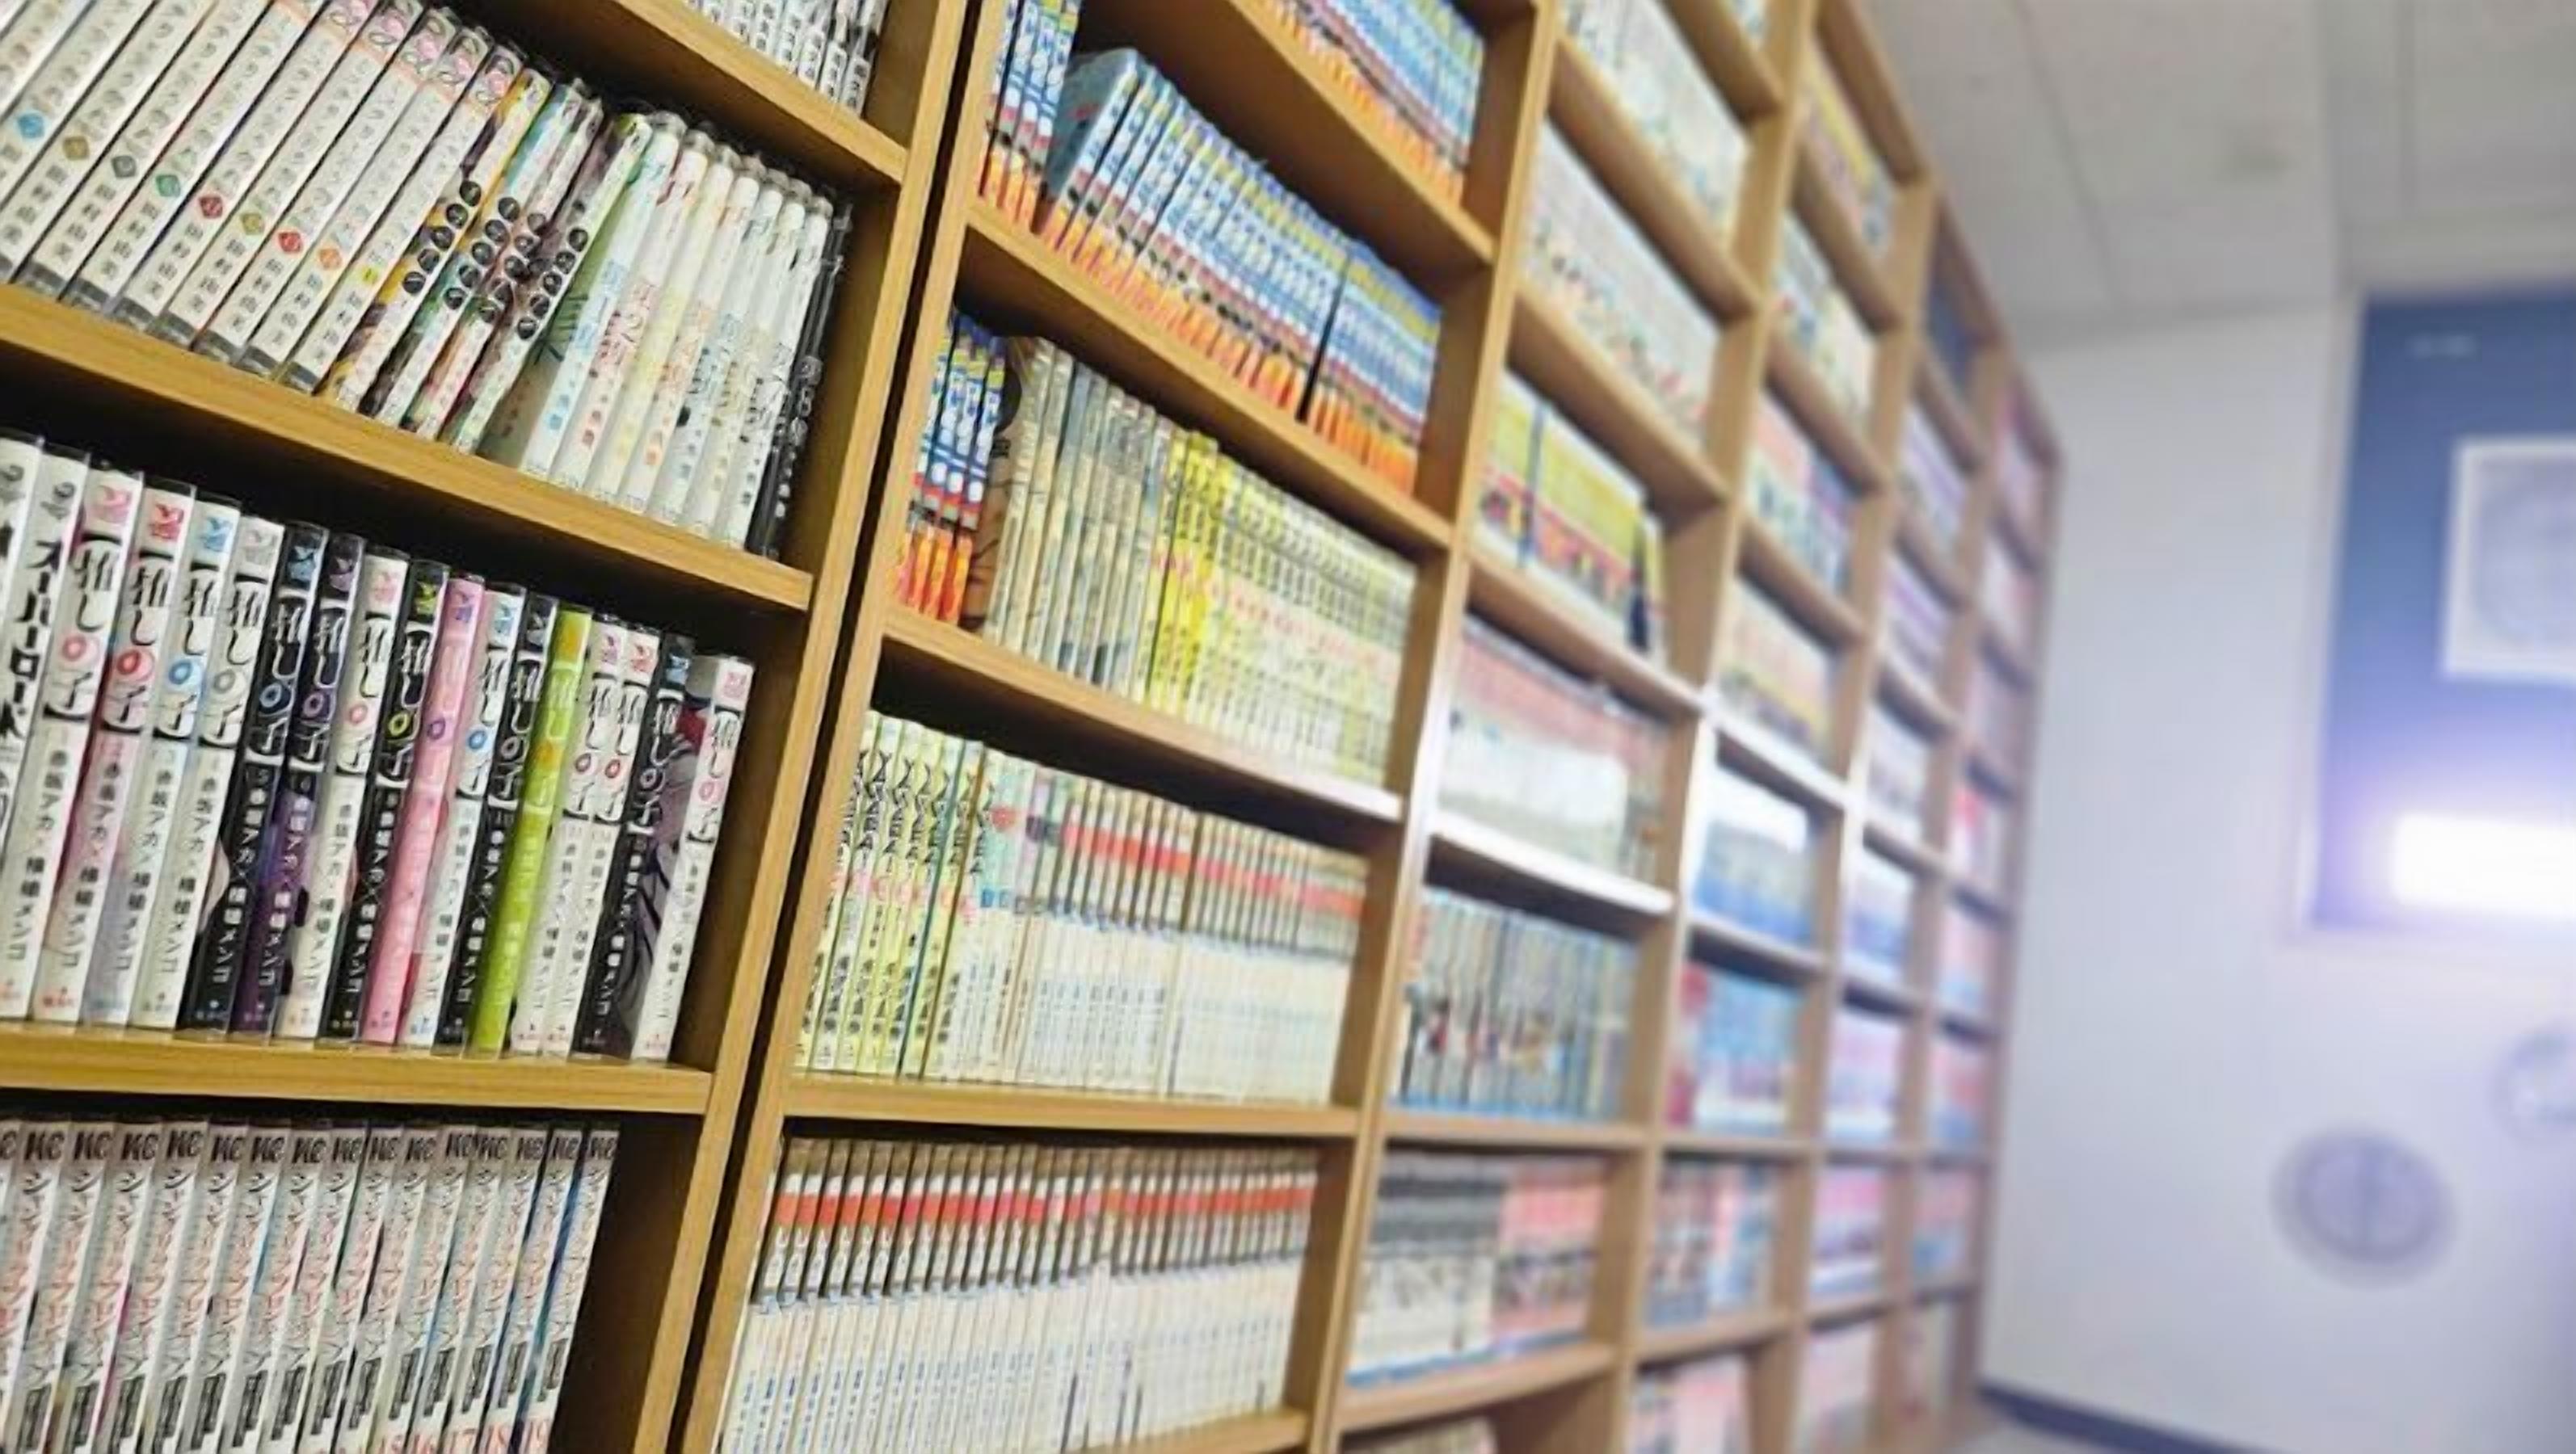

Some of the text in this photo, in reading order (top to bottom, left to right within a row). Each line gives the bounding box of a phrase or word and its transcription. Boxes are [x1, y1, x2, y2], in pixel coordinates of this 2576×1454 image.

[0, 1130, 17, 1160] C
[23, 1132, 65, 1160] KC
[73, 1132, 112, 1160] KC
[120, 1133, 159, 1162] KC
[166, 1130, 204, 1158] KC
[211, 1137, 243, 1162] KC
[250, 1137, 285, 1163] KC
[292, 1137, 327, 1163] KC
